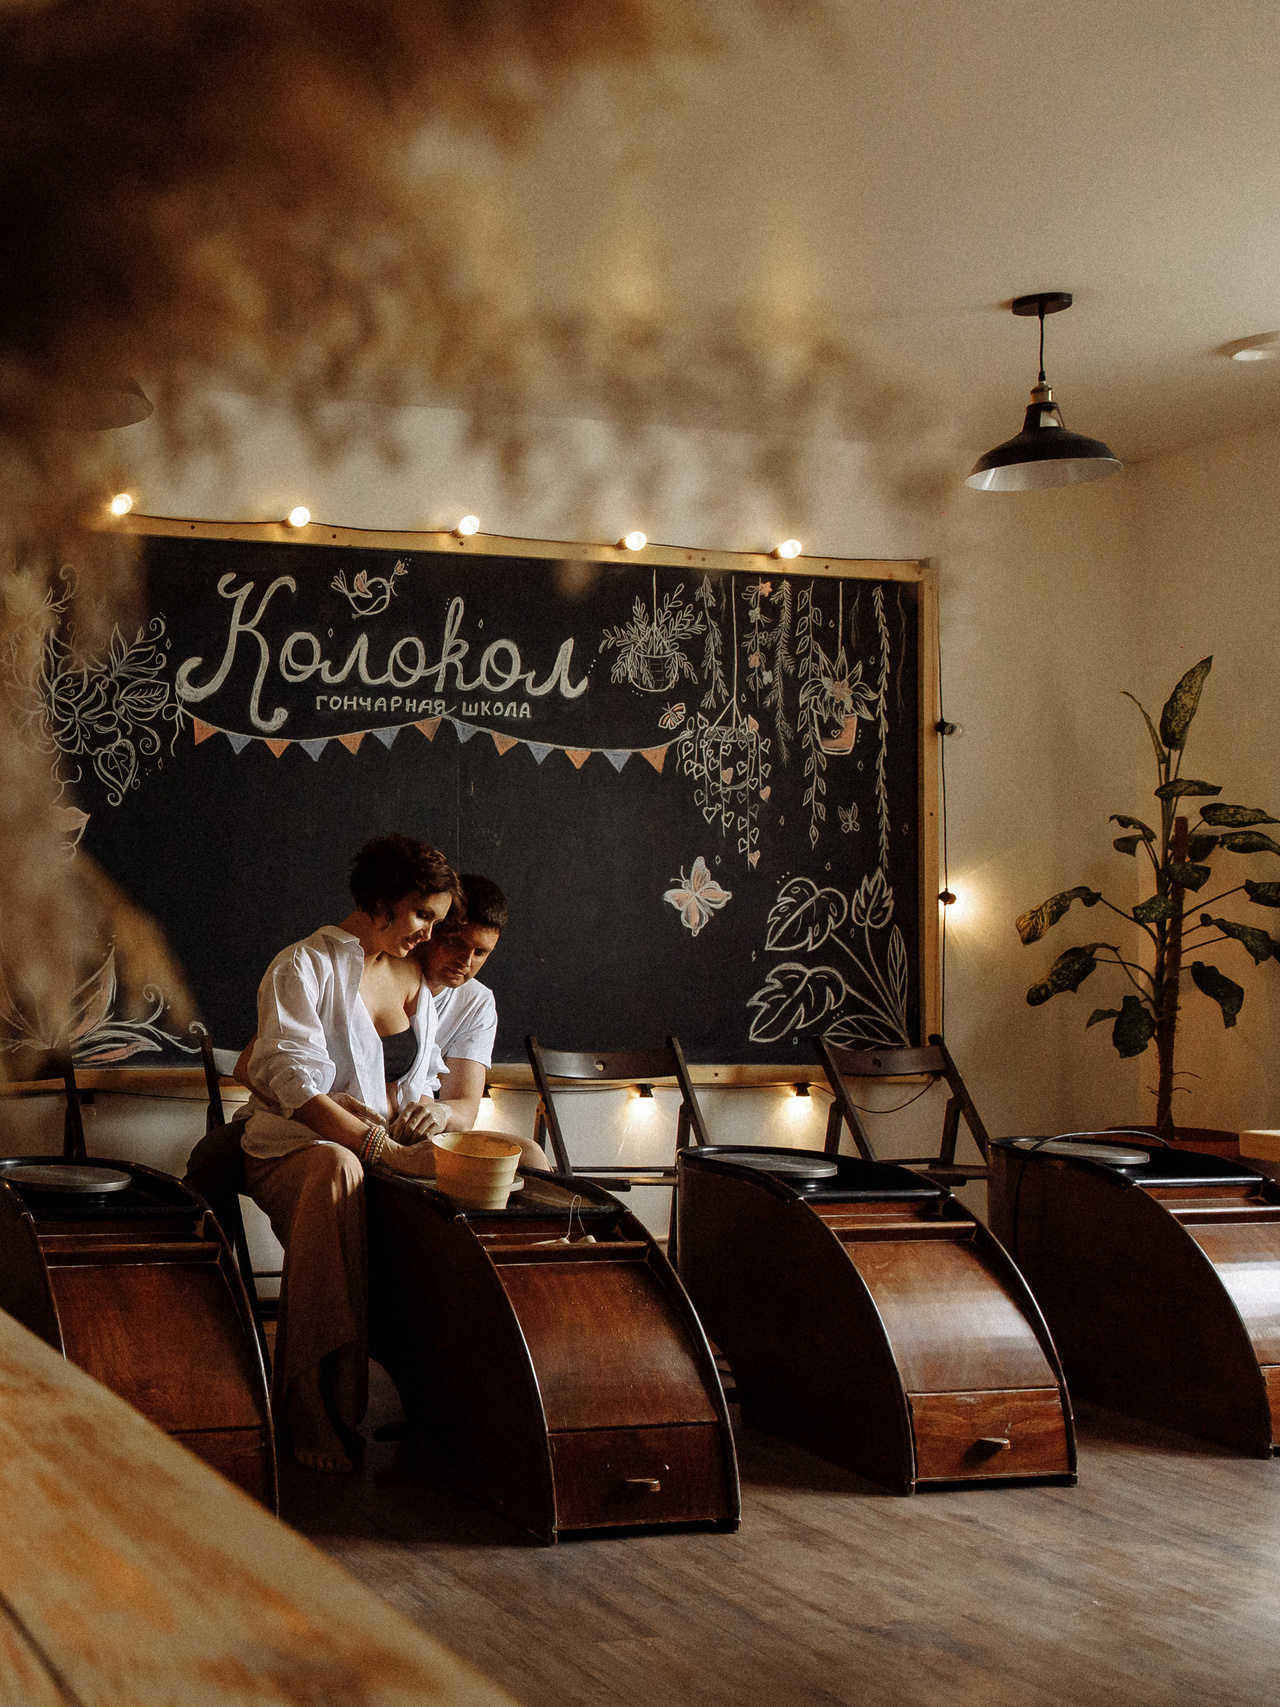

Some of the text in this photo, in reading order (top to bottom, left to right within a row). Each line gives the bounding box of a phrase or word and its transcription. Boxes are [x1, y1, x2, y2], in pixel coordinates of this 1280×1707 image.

[176, 573, 588, 731] Колокол
[315, 695, 532, 719] ГОНЧАРНАЯ ШКОЛА
